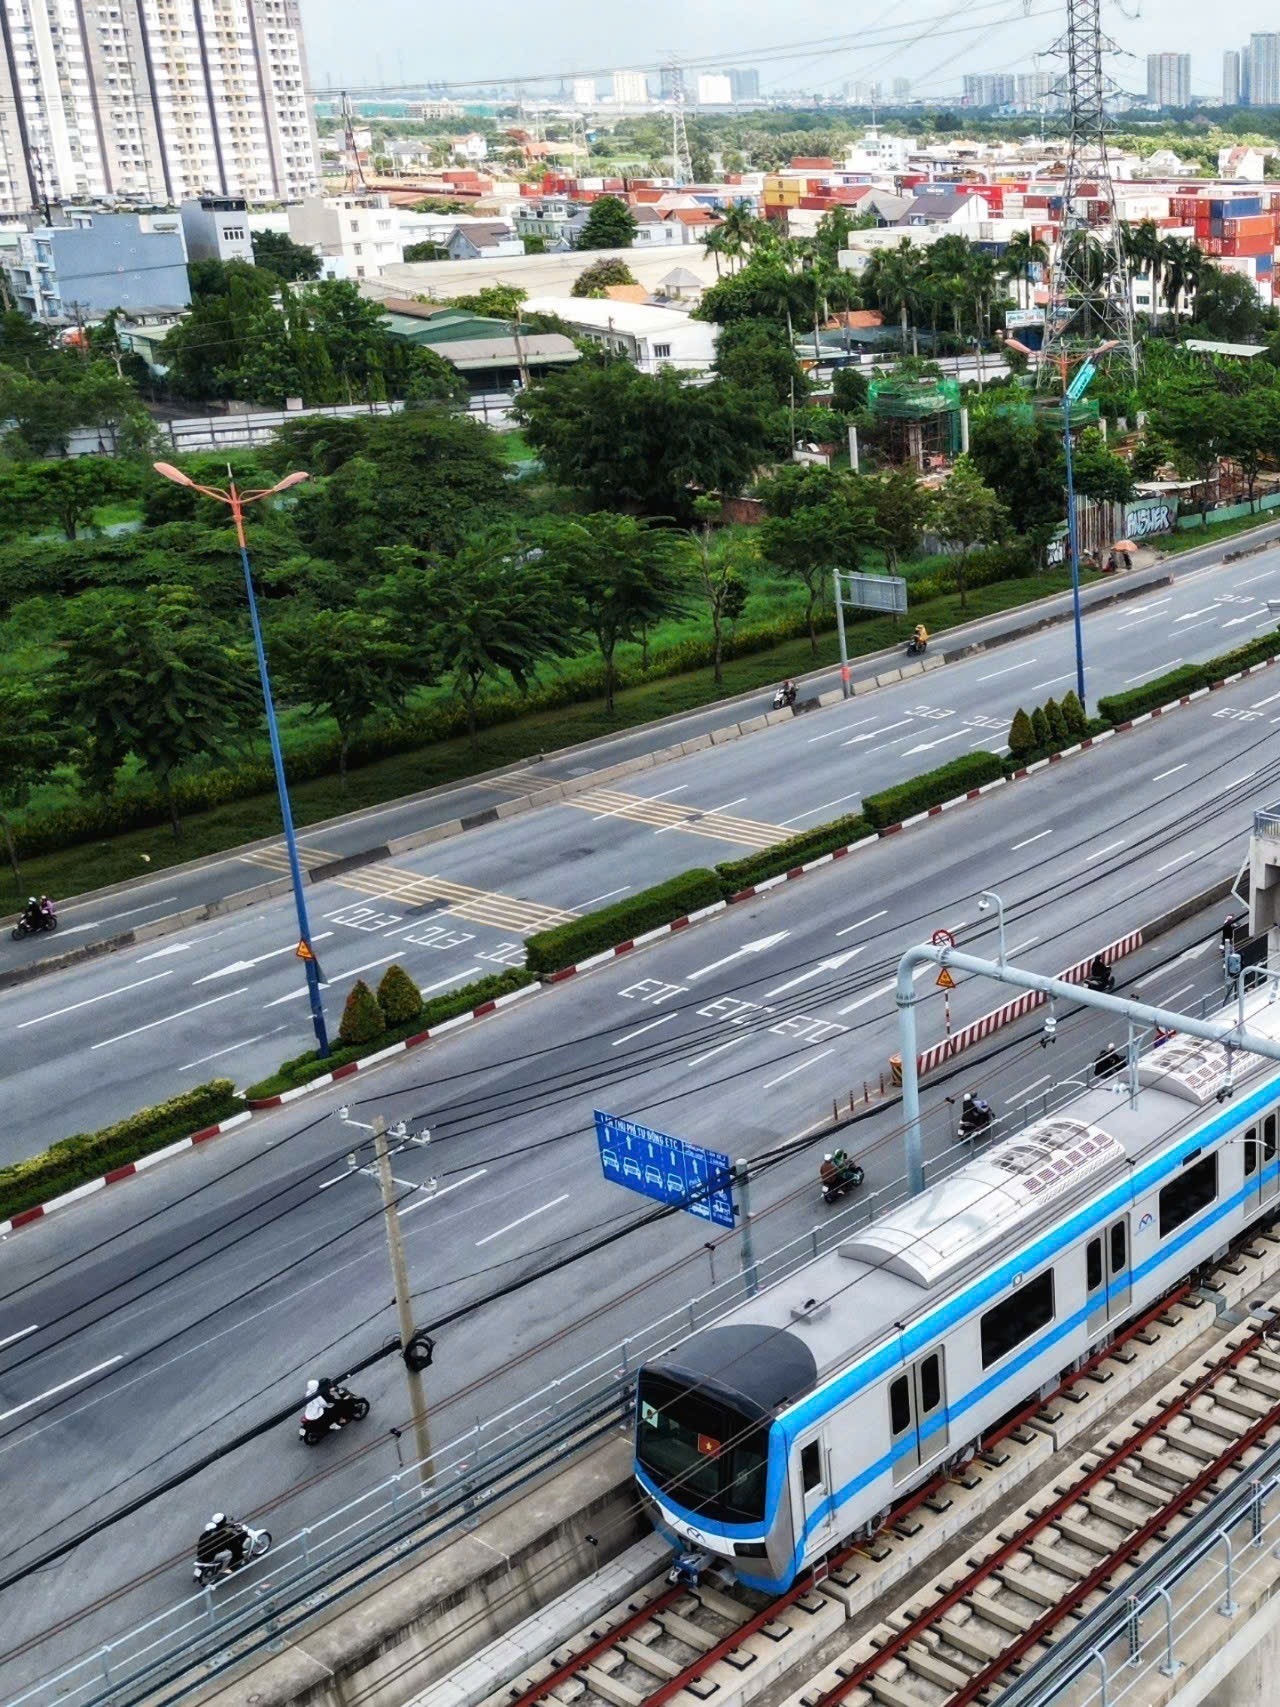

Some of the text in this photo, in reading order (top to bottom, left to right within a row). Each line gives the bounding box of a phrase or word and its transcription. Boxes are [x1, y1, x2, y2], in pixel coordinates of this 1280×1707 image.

[904, 705, 957, 720] ETC
[961, 715, 1014, 729] ETC
[1212, 707, 1265, 721] ETC
[331, 908, 403, 932] ETC
[403, 926, 476, 950] ETC
[696, 997, 776, 1025] ETC
[768, 1015, 850, 1044] ETC
[665, 1135, 678, 1149] ETC
